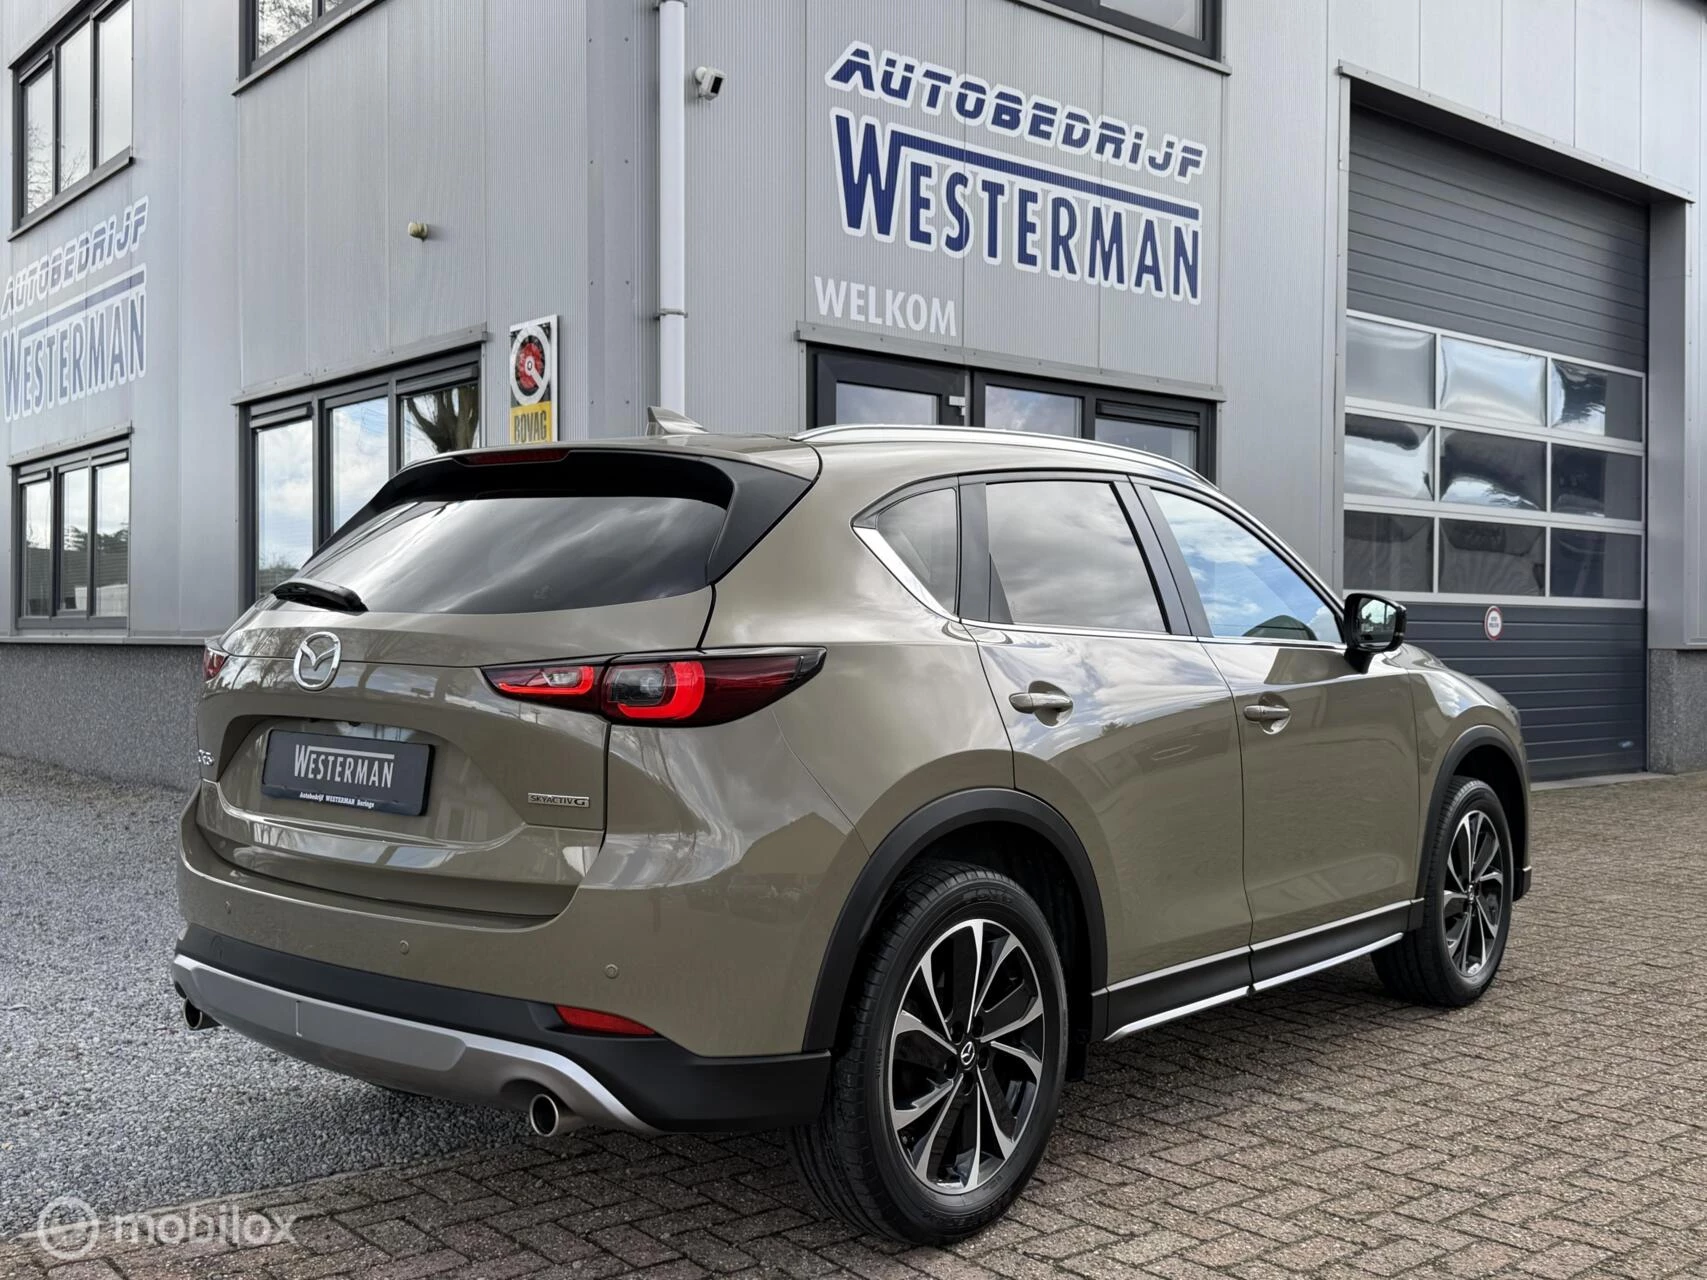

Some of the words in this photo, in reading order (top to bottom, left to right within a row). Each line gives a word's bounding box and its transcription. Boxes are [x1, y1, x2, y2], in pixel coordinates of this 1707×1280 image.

[828, 43, 1205, 181] AUTOBEDRIJF
[833, 113, 1200, 300] WESTERMAN
[1, 197, 148, 318] AUTOBEDRIJF
[814, 275, 957, 337] WELKOM
[2, 292, 147, 421] WESTERMAN
[513, 410, 547, 442] BOVAG
[294, 744, 394, 789] WESTERMAN
[325, 795, 355, 805] WESTERMAN
